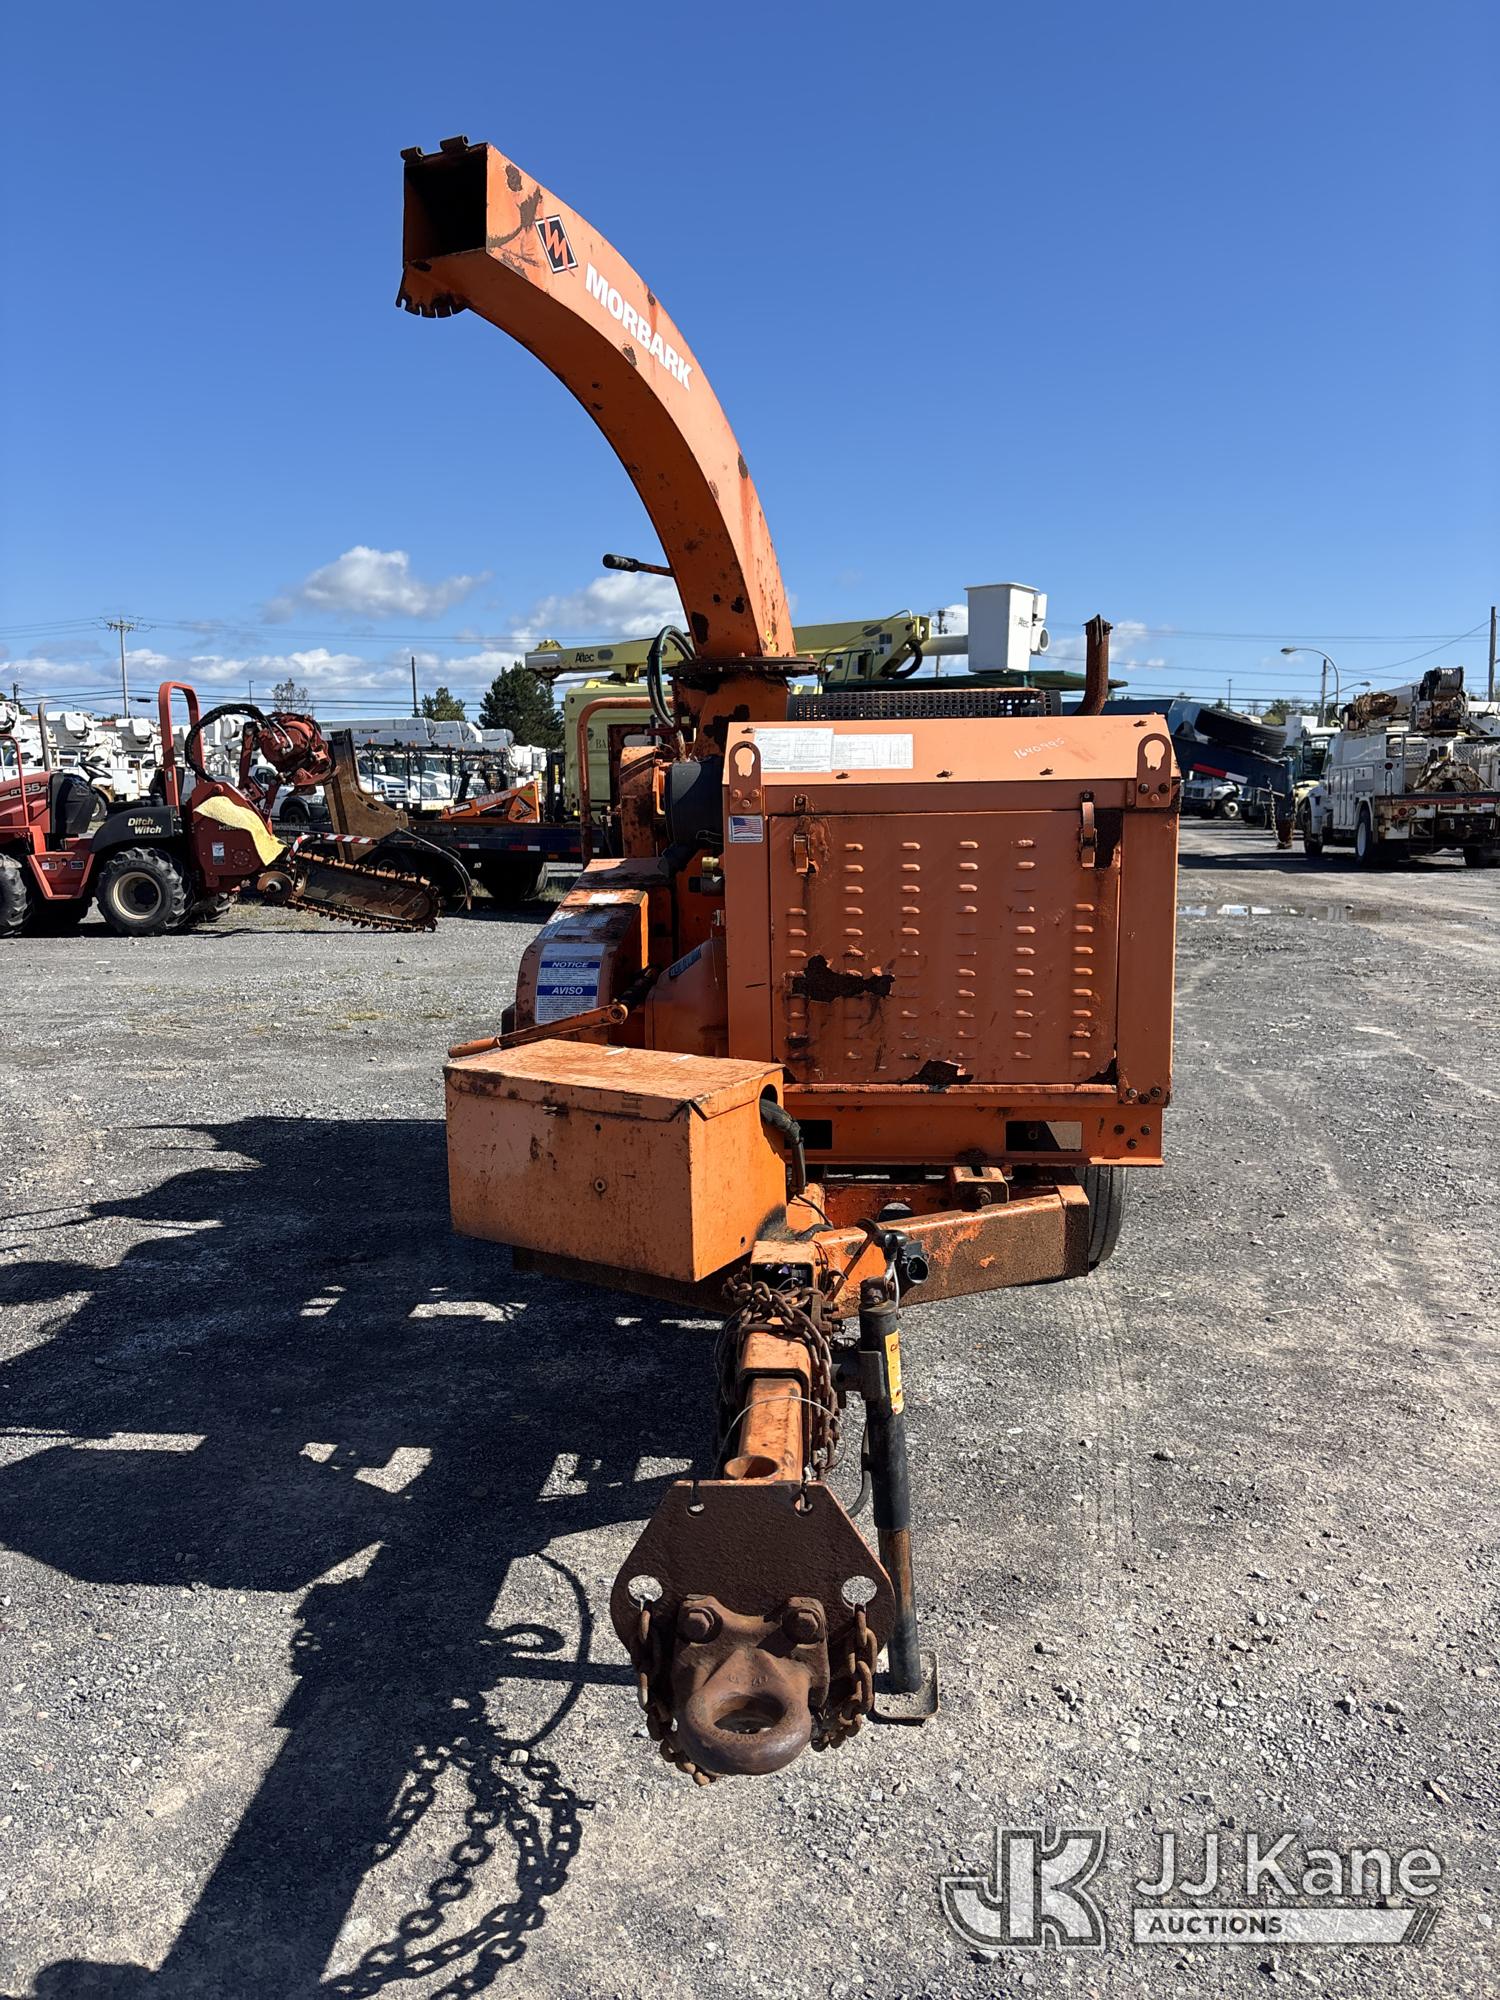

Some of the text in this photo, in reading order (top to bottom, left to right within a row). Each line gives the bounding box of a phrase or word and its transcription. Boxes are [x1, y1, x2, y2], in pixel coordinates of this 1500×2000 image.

[585, 262, 692, 392] MORBARK
[127, 816, 154, 827] Ditch
[134, 825, 162, 835] Witch
[551, 986, 584, 995] AVISO
